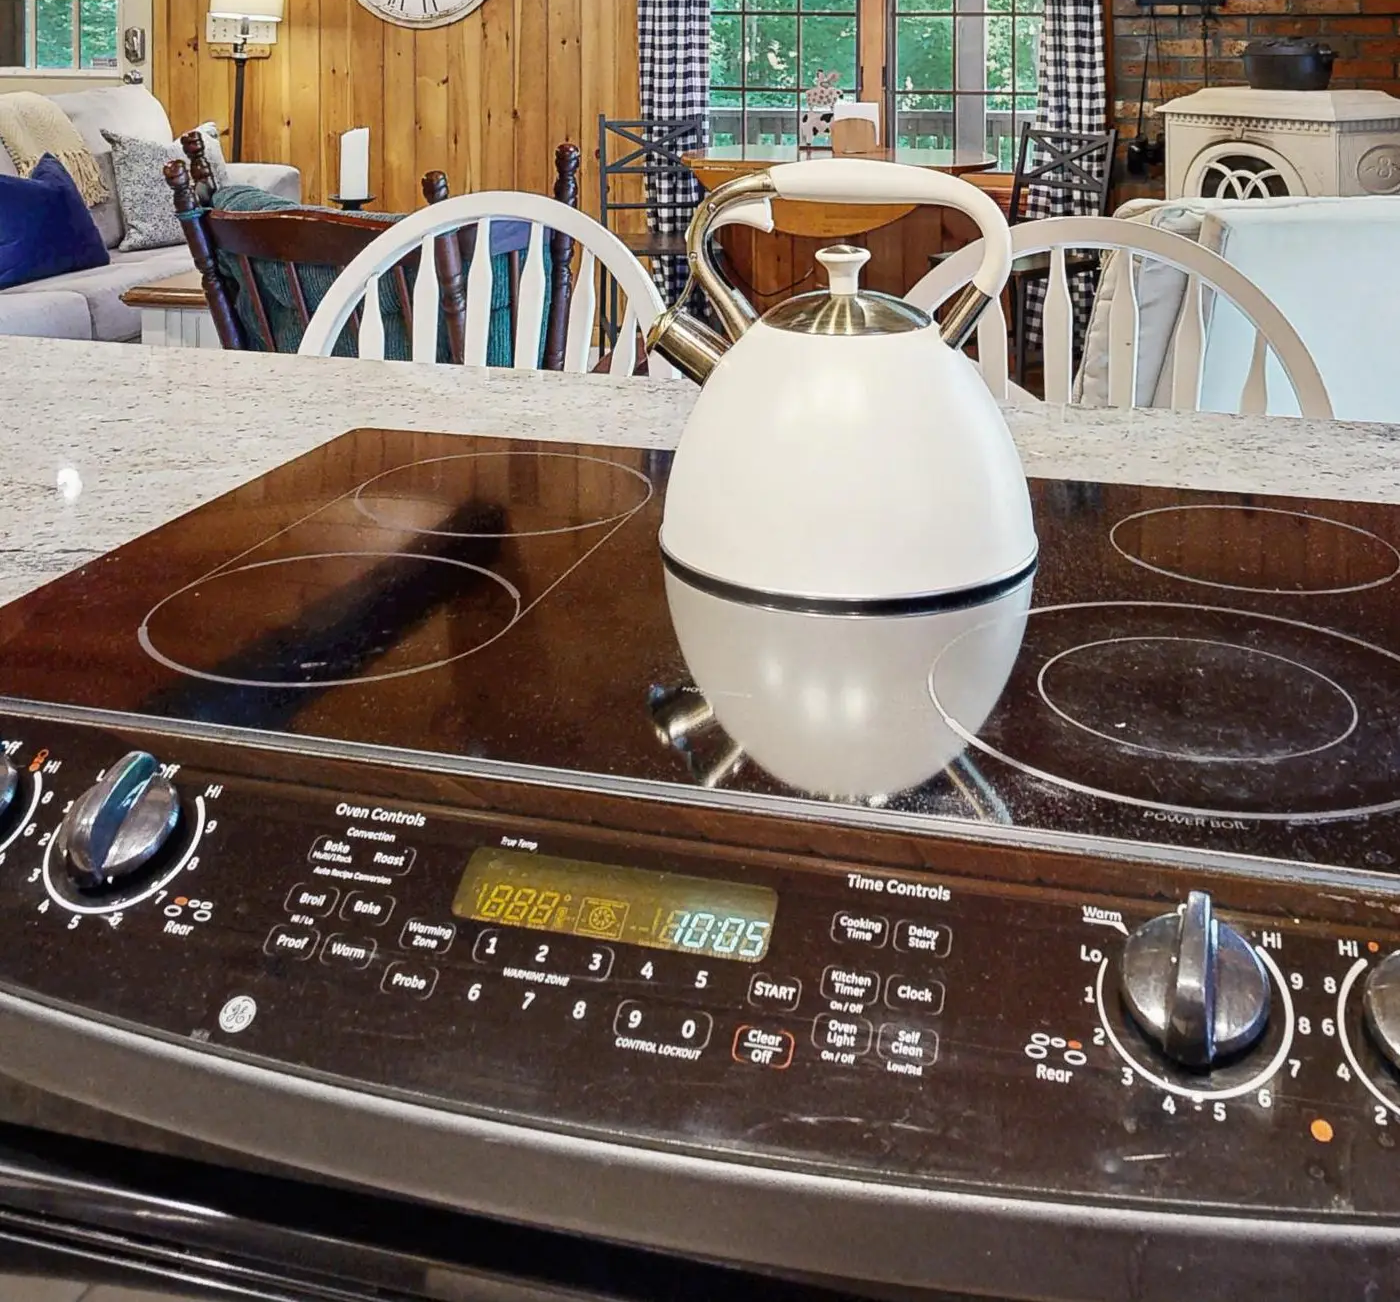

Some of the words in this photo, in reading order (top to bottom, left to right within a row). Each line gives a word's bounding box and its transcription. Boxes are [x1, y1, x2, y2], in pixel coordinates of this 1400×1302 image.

[43, 760, 62, 774] Hi
[41, 791, 54, 804] 8
[205, 784, 224, 798] Hi
[335, 802, 369, 819] Oven
[370, 807, 427, 827] Controls
[1143, 810, 1206, 827] POWER
[24, 823, 37, 837] 6
[205, 820, 218, 834] 9
[346, 827, 396, 842] Convection
[37, 833, 50, 846] 2
[500, 836, 517, 848] True
[518, 838, 539, 851] Temp
[323, 840, 350, 854] Bake
[373, 852, 405, 866] Roast
[187, 857, 200, 870] 8
[28, 868, 41, 882] 3
[847, 873, 884, 892] Time
[886, 880, 951, 901] Controls
[155, 890, 168, 904] 7
[299, 892, 327, 907] Broil
[37, 899, 50, 913] 4
[353, 900, 381, 915] Bake
[1082, 905, 1122, 922] Warm
[67, 915, 82, 929] 5
[164, 920, 194, 936] Rear
[408, 921, 453, 939] Warming
[839, 915, 882, 933] Cooking
[846, 927, 873, 941] Time
[908, 925, 939, 941] Delay
[1262, 931, 1282, 949] Hi
[276, 934, 309, 950] Proof
[412, 935, 438, 949] Zone
[908, 936, 936, 950] Start
[1338, 939, 1359, 958] Hi
[331, 943, 366, 959] Warm
[1080, 944, 1103, 963] Lo
[485, 937, 498, 954] 1
[535, 945, 549, 962] 2
[588, 953, 603, 971] 3
[640, 961, 654, 980] 4
[695, 970, 709, 989] 5
[391, 973, 427, 990] Probe
[503, 966, 545, 983] WARMING
[545, 973, 570, 987] ZONE
[831, 970, 872, 987] Kitchen
[1290, 972, 1303, 990] 9
[1323, 976, 1337, 994] 8
[753, 981, 796, 1001] START
[833, 983, 865, 998] Timer
[897, 985, 932, 1002] Clock
[1084, 986, 1095, 1003] 1
[467, 983, 482, 1001] 6
[521, 992, 536, 1010] 7
[572, 1000, 587, 1019] 8
[628, 1009, 642, 1028] 9
[681, 1020, 696, 1039] 0
[829, 1000, 843, 1011] On
[849, 1003, 864, 1014] Off
[828, 1019, 857, 1035] Oven
[1298, 1016, 1311, 1035] 8
[1322, 1019, 1335, 1036] 6
[748, 1029, 783, 1046] Clear
[826, 1032, 856, 1047] Light
[898, 1030, 921, 1045] Self
[1093, 1028, 1105, 1045] 2
[615, 1036, 657, 1054] CONTROL
[658, 1043, 702, 1061] LOCKOUT
[751, 1049, 773, 1064] Off
[891, 1041, 923, 1058] Clean
[821, 1050, 834, 1061] On
[840, 1053, 855, 1065] Off
[1036, 1063, 1073, 1083] Rear
[1121, 1067, 1134, 1085] 3
[1288, 1059, 1301, 1078] 7
[1336, 1063, 1351, 1082] 4
[1162, 1095, 1176, 1115] 4
[1258, 1089, 1272, 1108] 6
[1213, 1103, 1227, 1122] 5
[1374, 1105, 1388, 1126] 2
